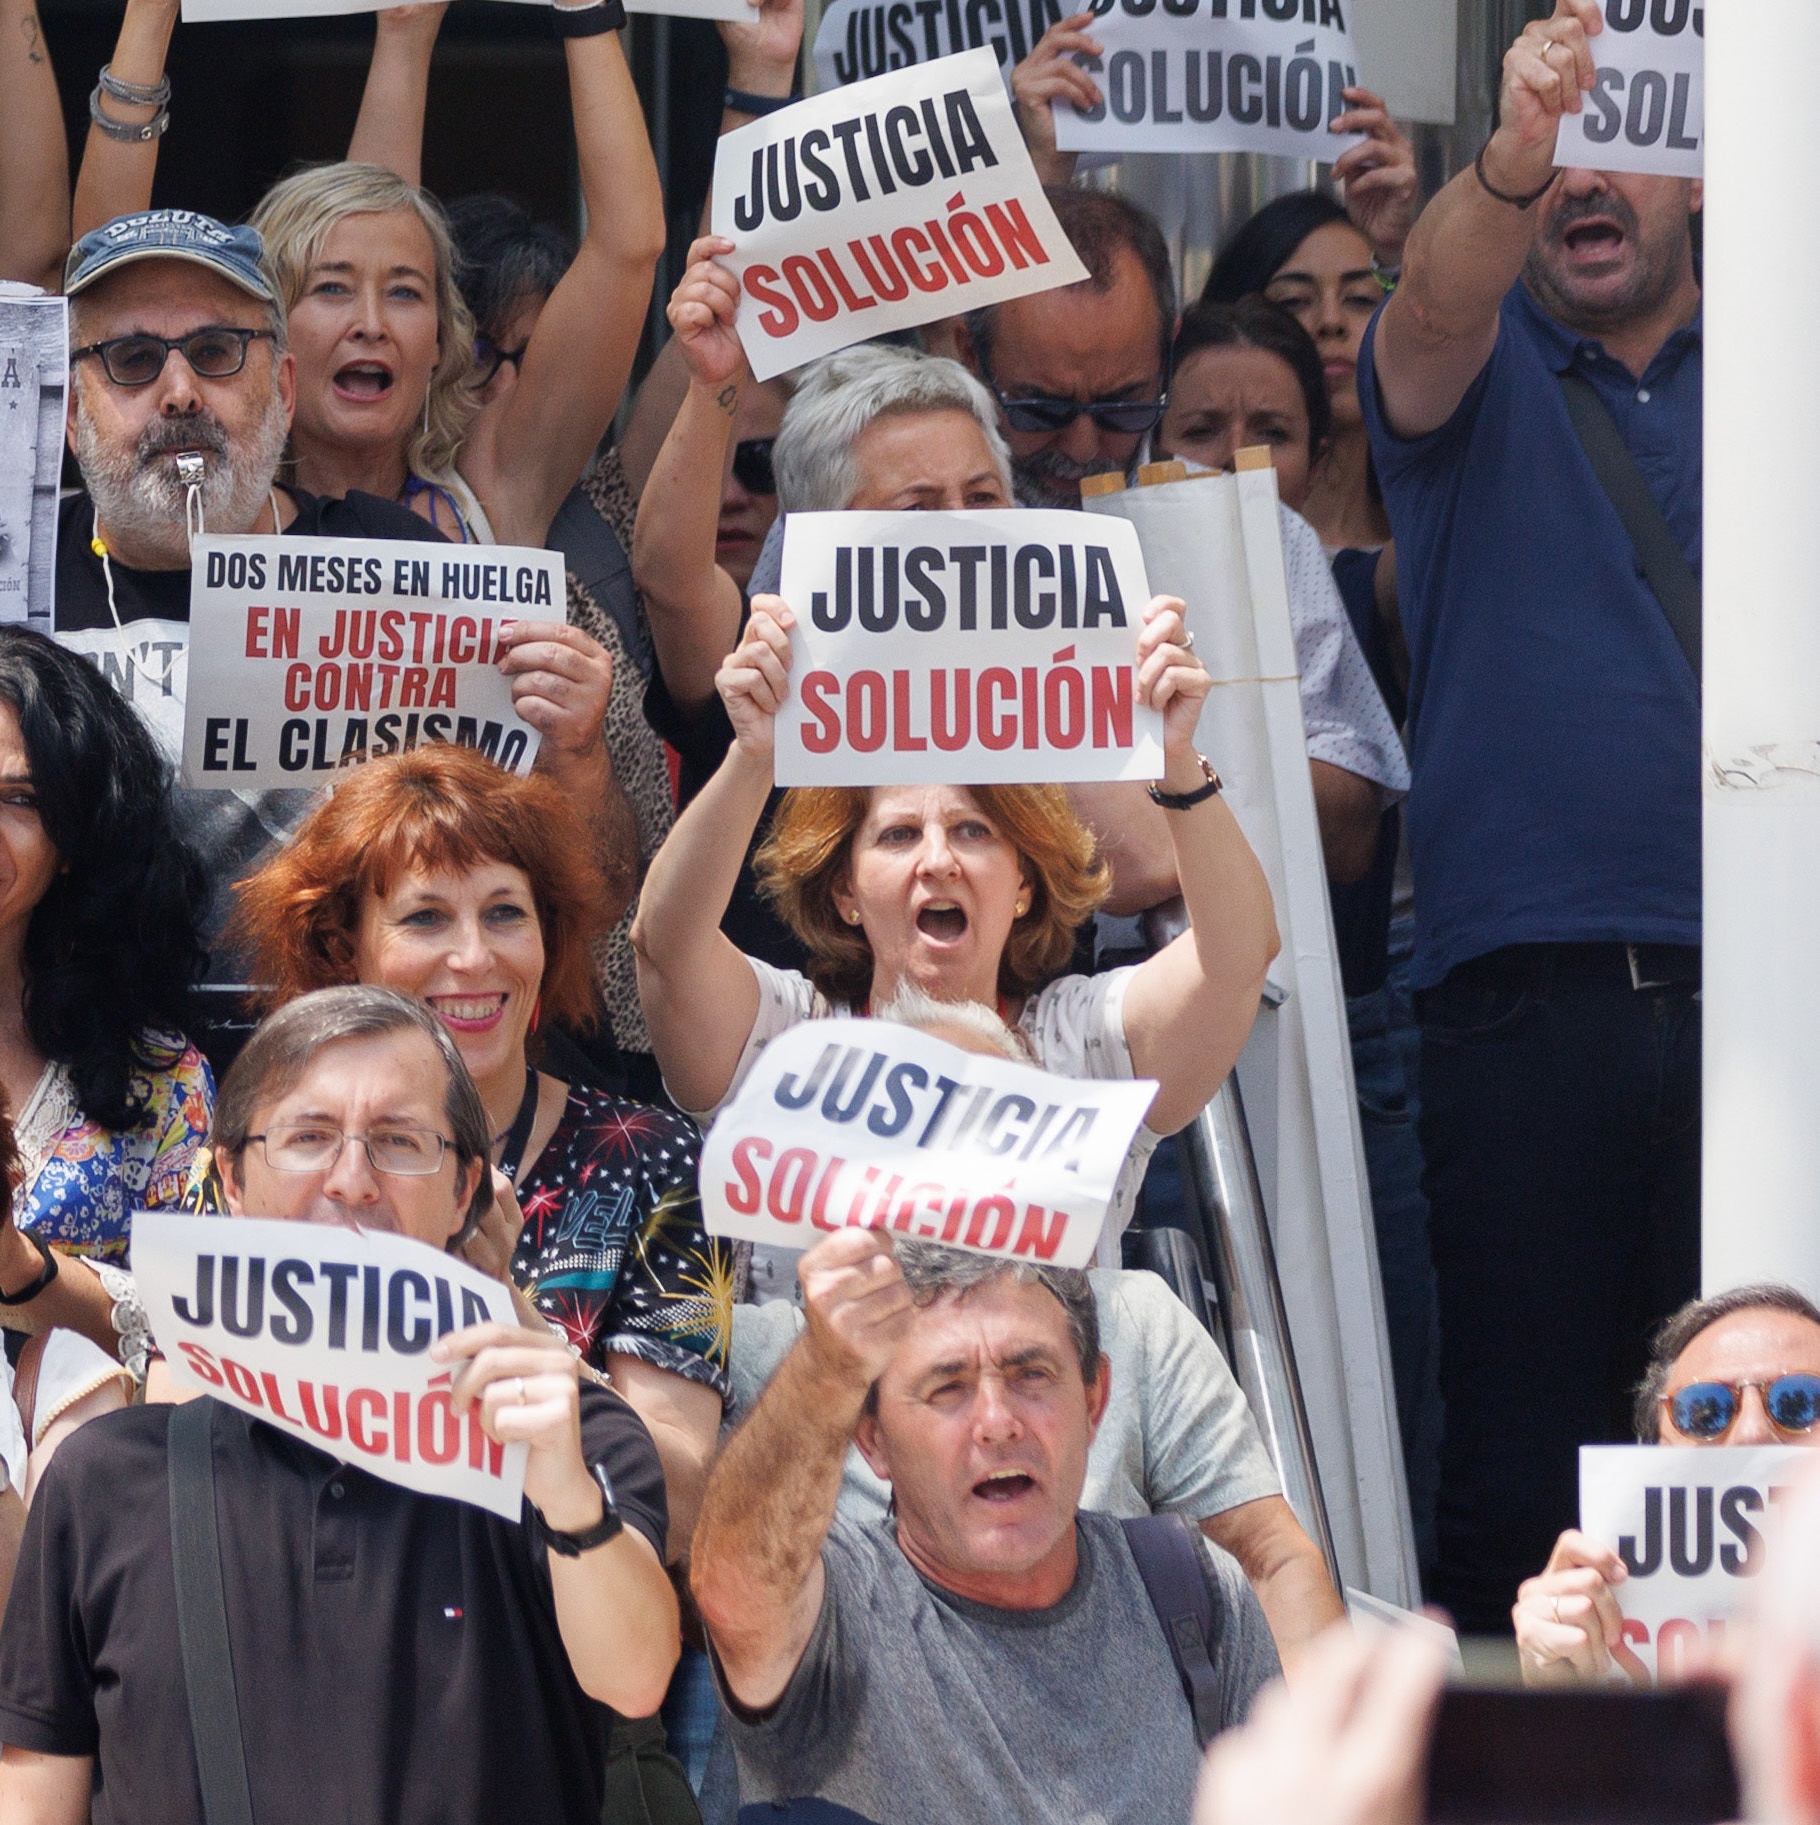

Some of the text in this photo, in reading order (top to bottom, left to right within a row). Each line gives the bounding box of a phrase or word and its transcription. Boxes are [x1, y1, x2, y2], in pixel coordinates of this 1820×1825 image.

[733, 88, 1000, 232] JUSTICIA
[742, 190, 1050, 338] SOLUCIÓN
[206, 552, 553, 606] DOS MESES EN HUELGA
[811, 543, 1127, 633] JUSTICIA
[246, 606, 301, 659] EN
[284, 662, 457, 712] CONTRA
[800, 644, 1133, 753] SOLUCIÓN
[203, 717, 257, 771] EL
[773, 1042, 1100, 1173] JUSTICIA
[724, 1136, 1070, 1262] SOLUCIÓN
